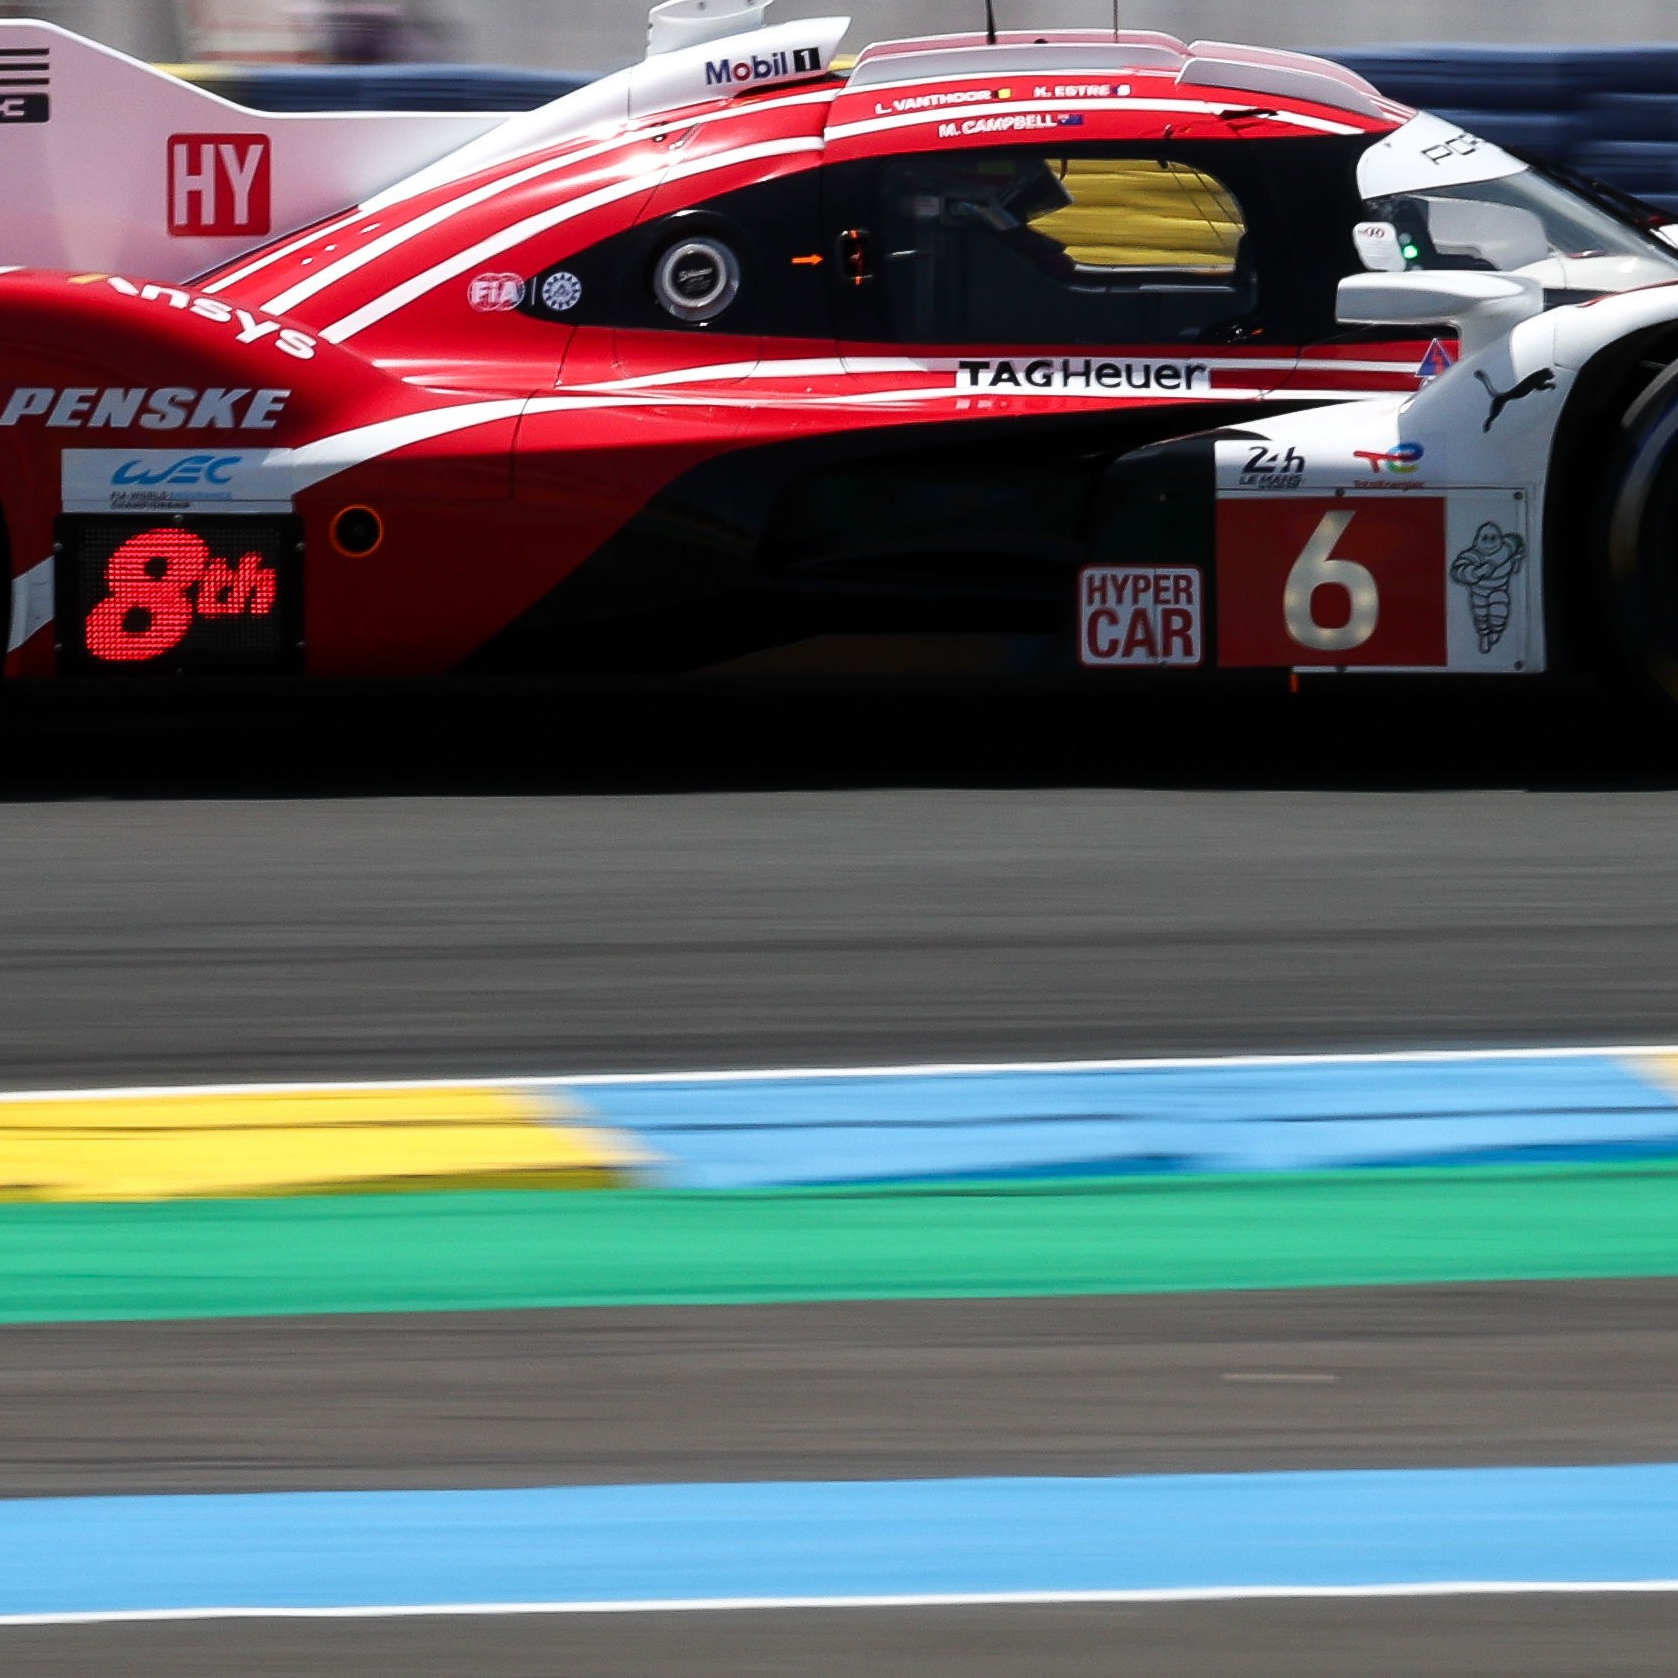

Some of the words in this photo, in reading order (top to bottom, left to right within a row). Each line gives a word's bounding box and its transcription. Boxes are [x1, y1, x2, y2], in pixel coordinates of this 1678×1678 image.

[704, 51, 788, 86] Mobil
[875, 102, 892, 115] L.
[893, 89, 993, 111] VANTHOOR
[1033, 85, 1052, 98] K.
[1054, 84, 1111, 97] ESTRE
[938, 121, 960, 139] M.
[961, 113, 1058, 135] CAMPBELL
[172, 141, 265, 228] HY
[67, 274, 319, 360] Ansys
[110, 454, 243, 485] WEC
[1241, 445, 1306, 474] 24h
[84, 527, 278, 662] 8th
[1086, 574, 1194, 606] HYPER
[1285, 509, 1380, 651] 6
[1086, 608, 1195, 658] CAR
